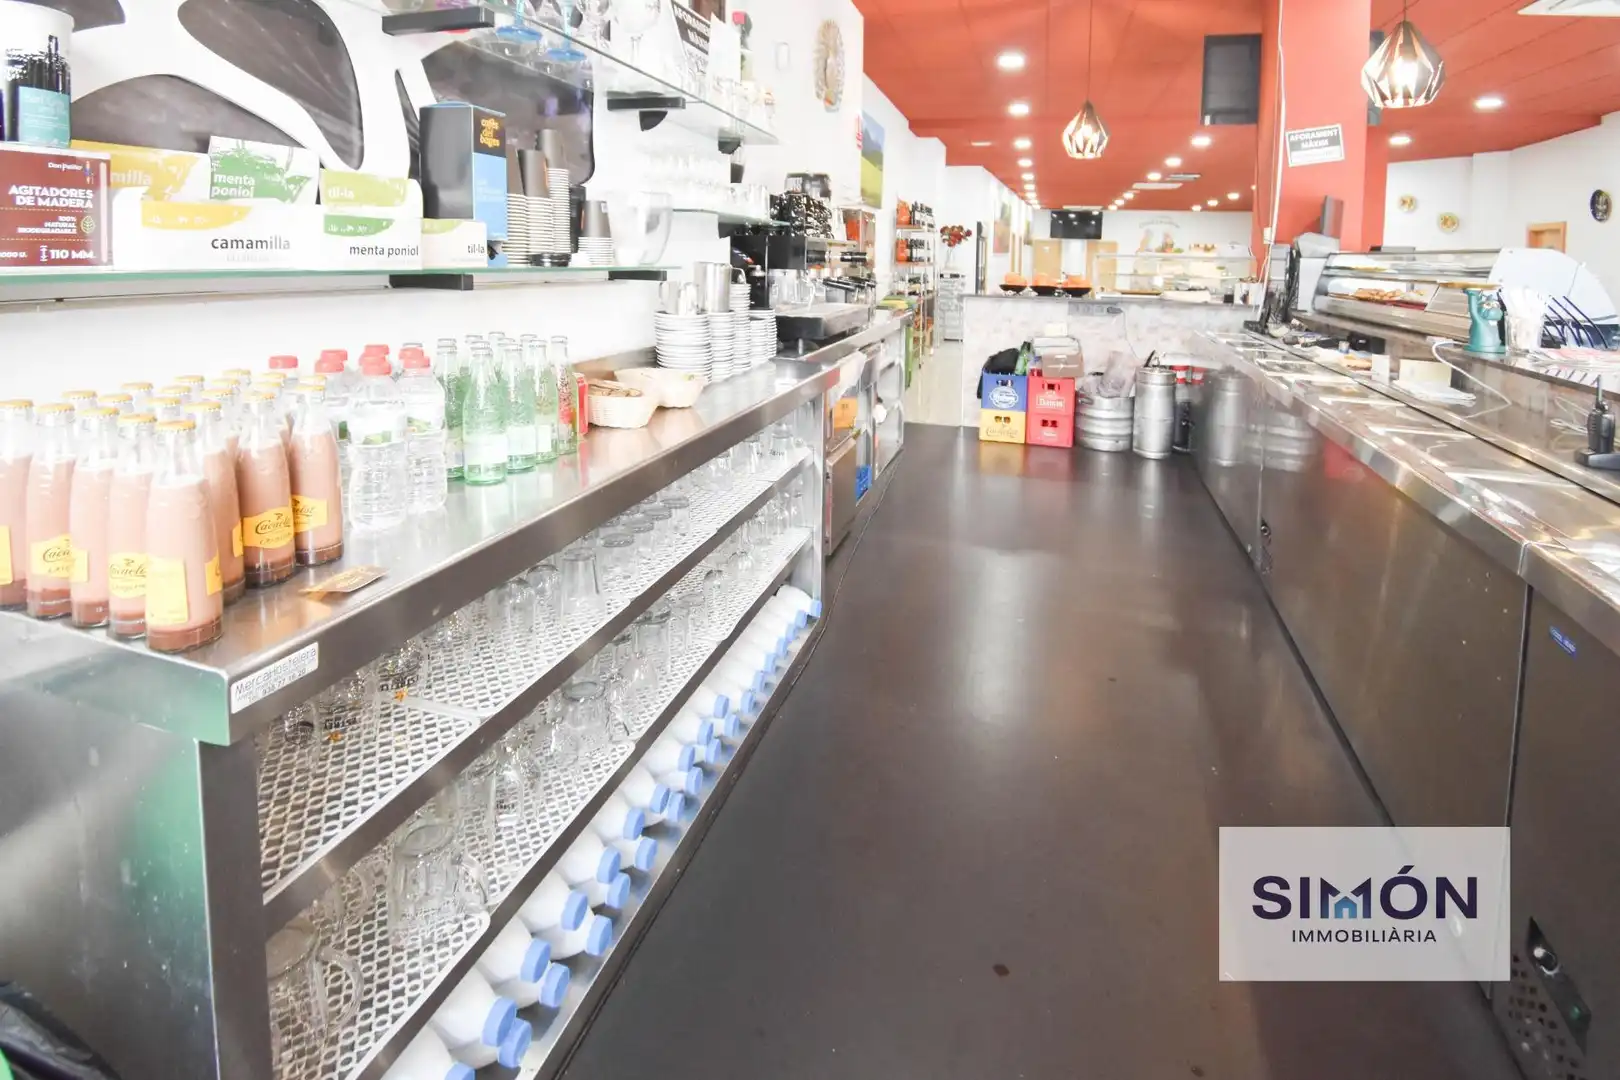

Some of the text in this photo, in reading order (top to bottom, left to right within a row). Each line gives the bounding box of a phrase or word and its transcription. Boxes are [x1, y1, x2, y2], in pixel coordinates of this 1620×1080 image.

[213, 173, 256, 186] menta
[8, 184, 94, 199] AGITADORES
[211, 184, 255, 198] poniol
[15, 195, 94, 209] DE MADERA
[211, 234, 291, 251] camamilla
[49, 249, 69, 260] 110
[349, 244, 419, 259] menta poniol
